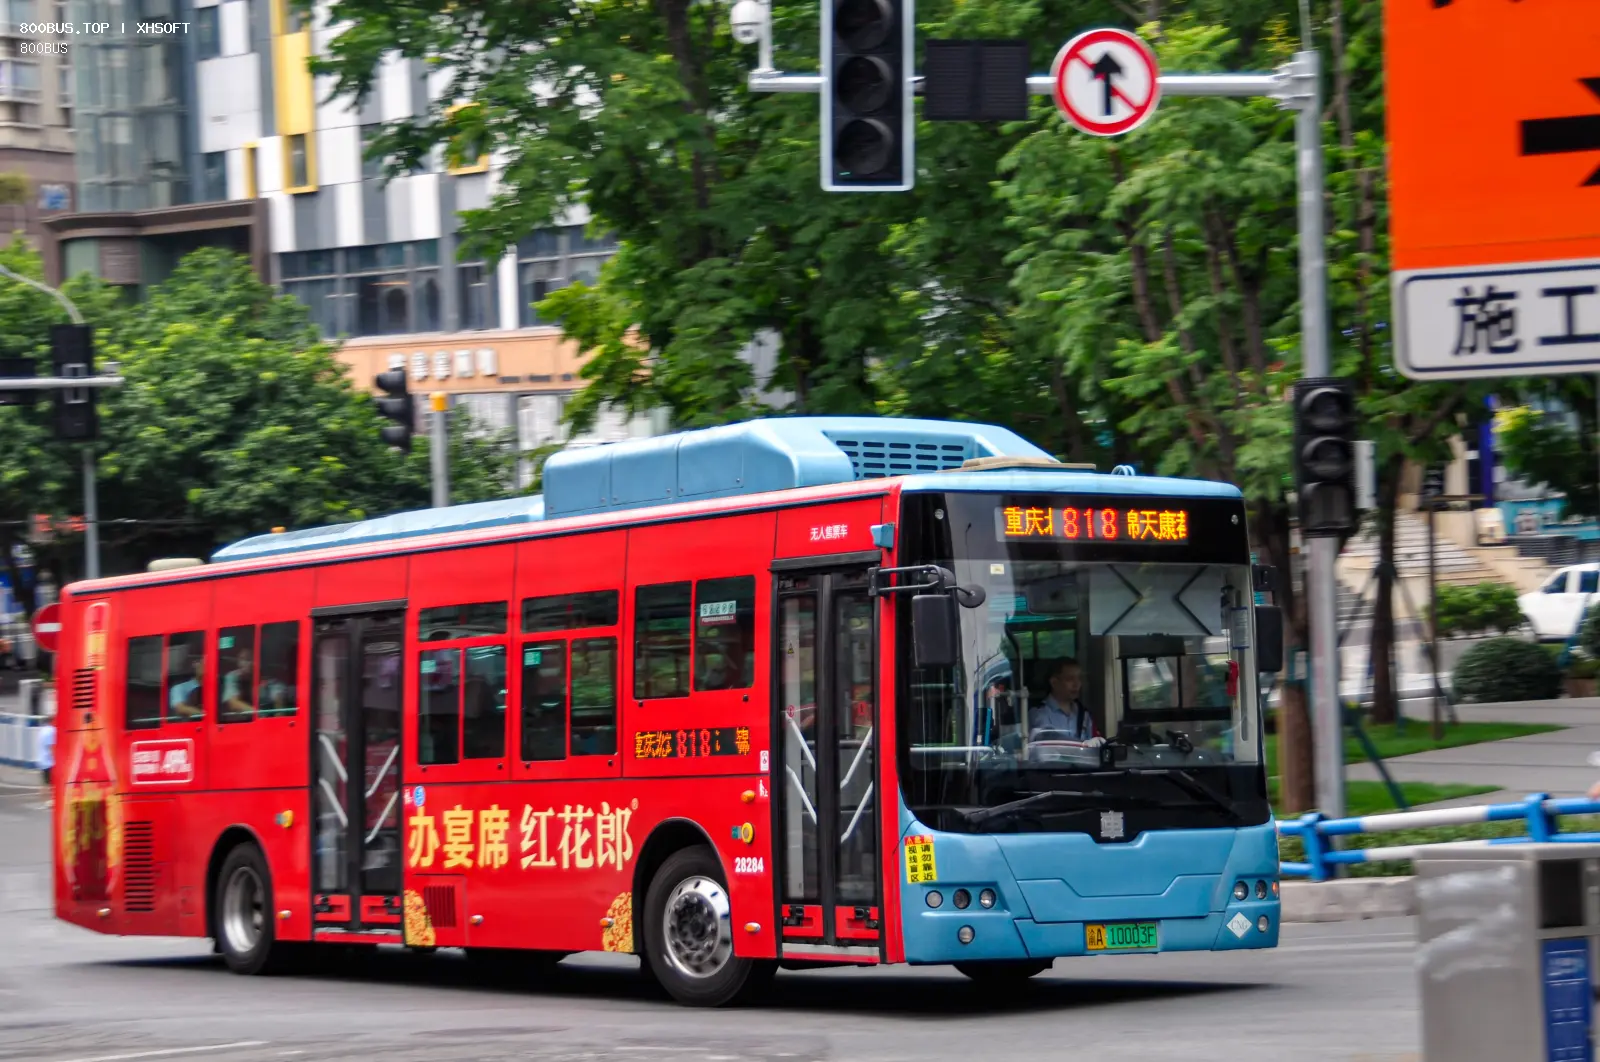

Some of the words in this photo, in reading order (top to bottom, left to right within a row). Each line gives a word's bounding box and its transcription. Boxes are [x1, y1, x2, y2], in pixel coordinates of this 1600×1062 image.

[1453, 285, 1600, 355] 施工
[810, 524, 848, 541] 无人售票车
[1062, 507, 1117, 539] 818
[676, 729, 711, 758] 818
[407, 804, 510, 869] 办宴席
[519, 801, 634, 871] 红花郎
[735, 857, 764, 873] 28284
[1230, 919, 1248, 931] CNG
